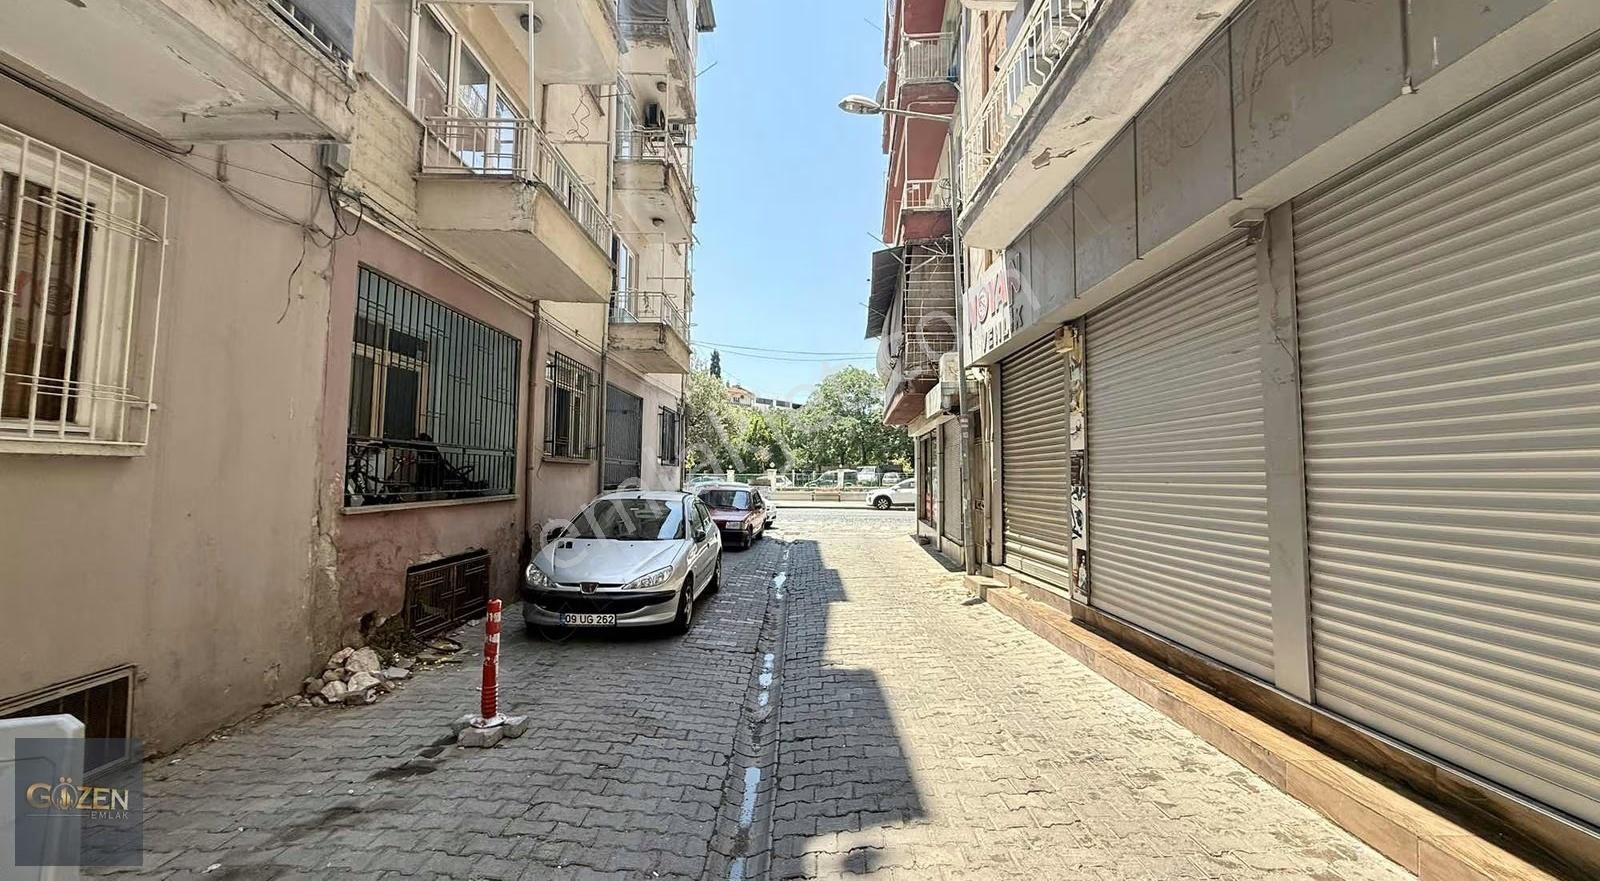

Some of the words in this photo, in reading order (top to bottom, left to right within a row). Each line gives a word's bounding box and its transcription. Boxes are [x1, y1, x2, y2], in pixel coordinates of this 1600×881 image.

[565, 614, 577, 624] 09
[580, 614, 594, 624] UG
[596, 614, 615, 624] 262
